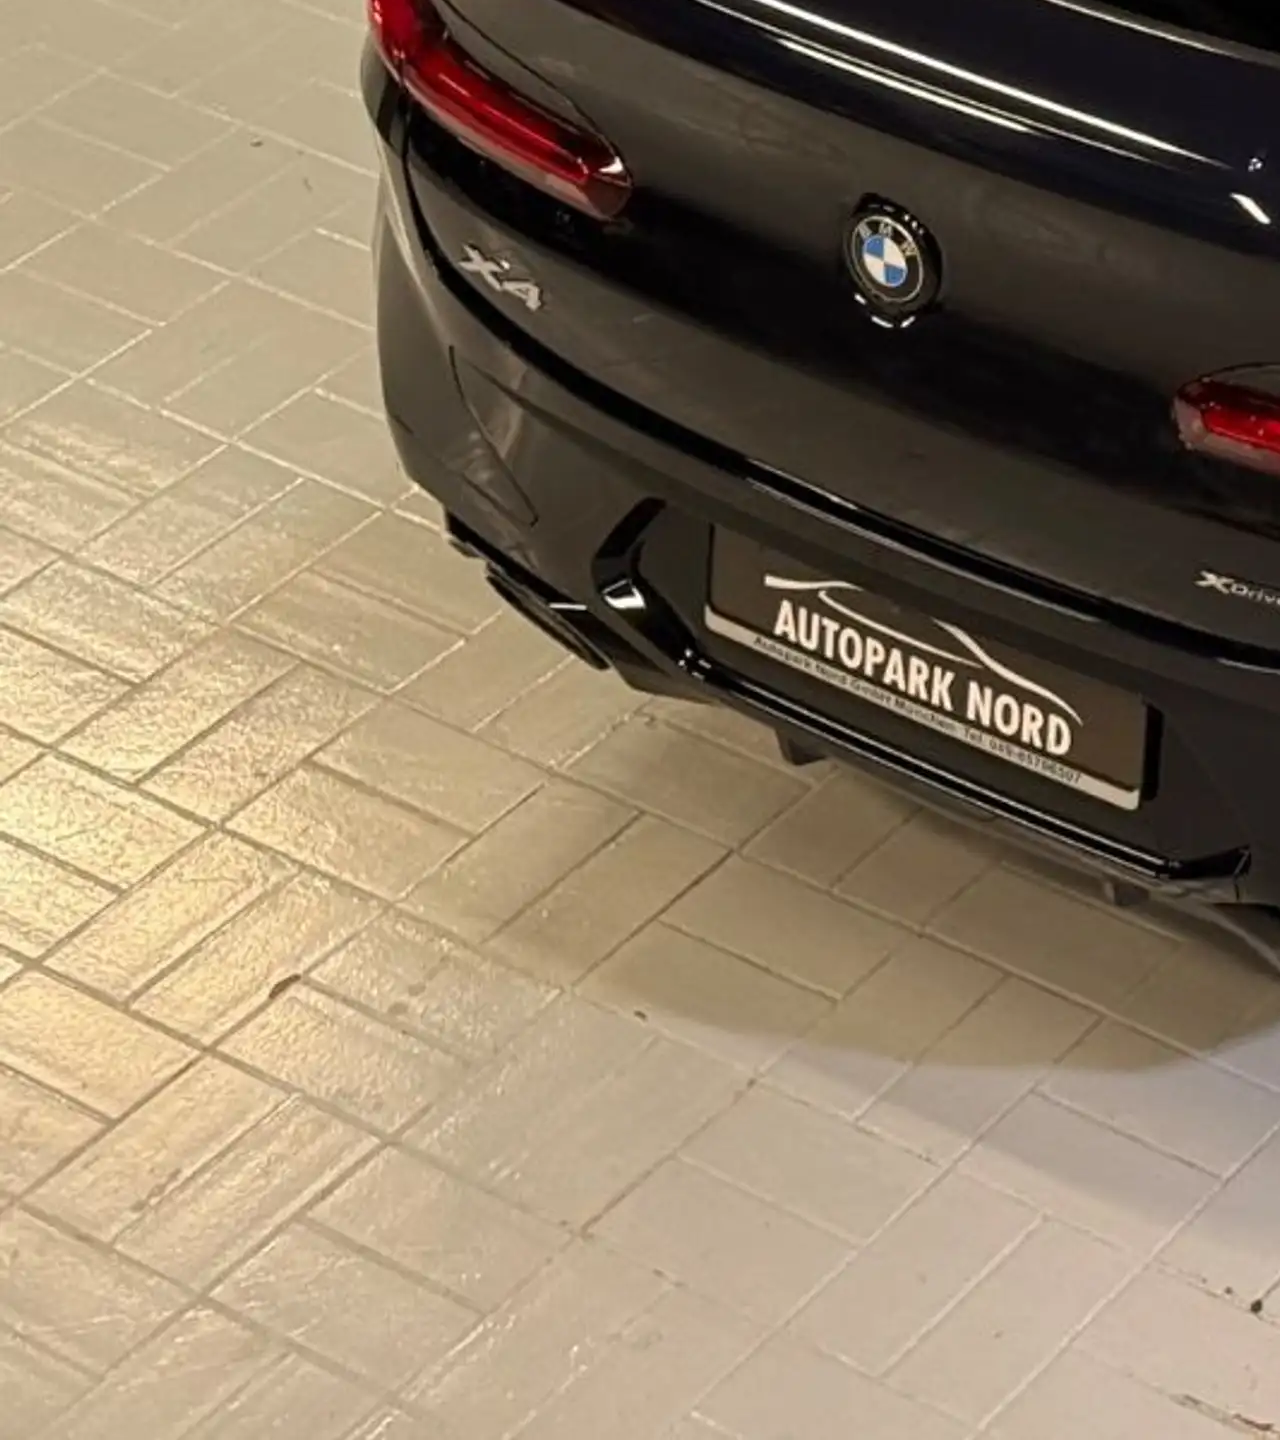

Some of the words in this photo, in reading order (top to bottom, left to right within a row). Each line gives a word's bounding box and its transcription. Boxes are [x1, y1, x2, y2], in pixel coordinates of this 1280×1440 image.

[458, 244, 542, 312] X4
[773, 599, 953, 712] AUTOPARK
[966, 680, 1072, 756] NORD
